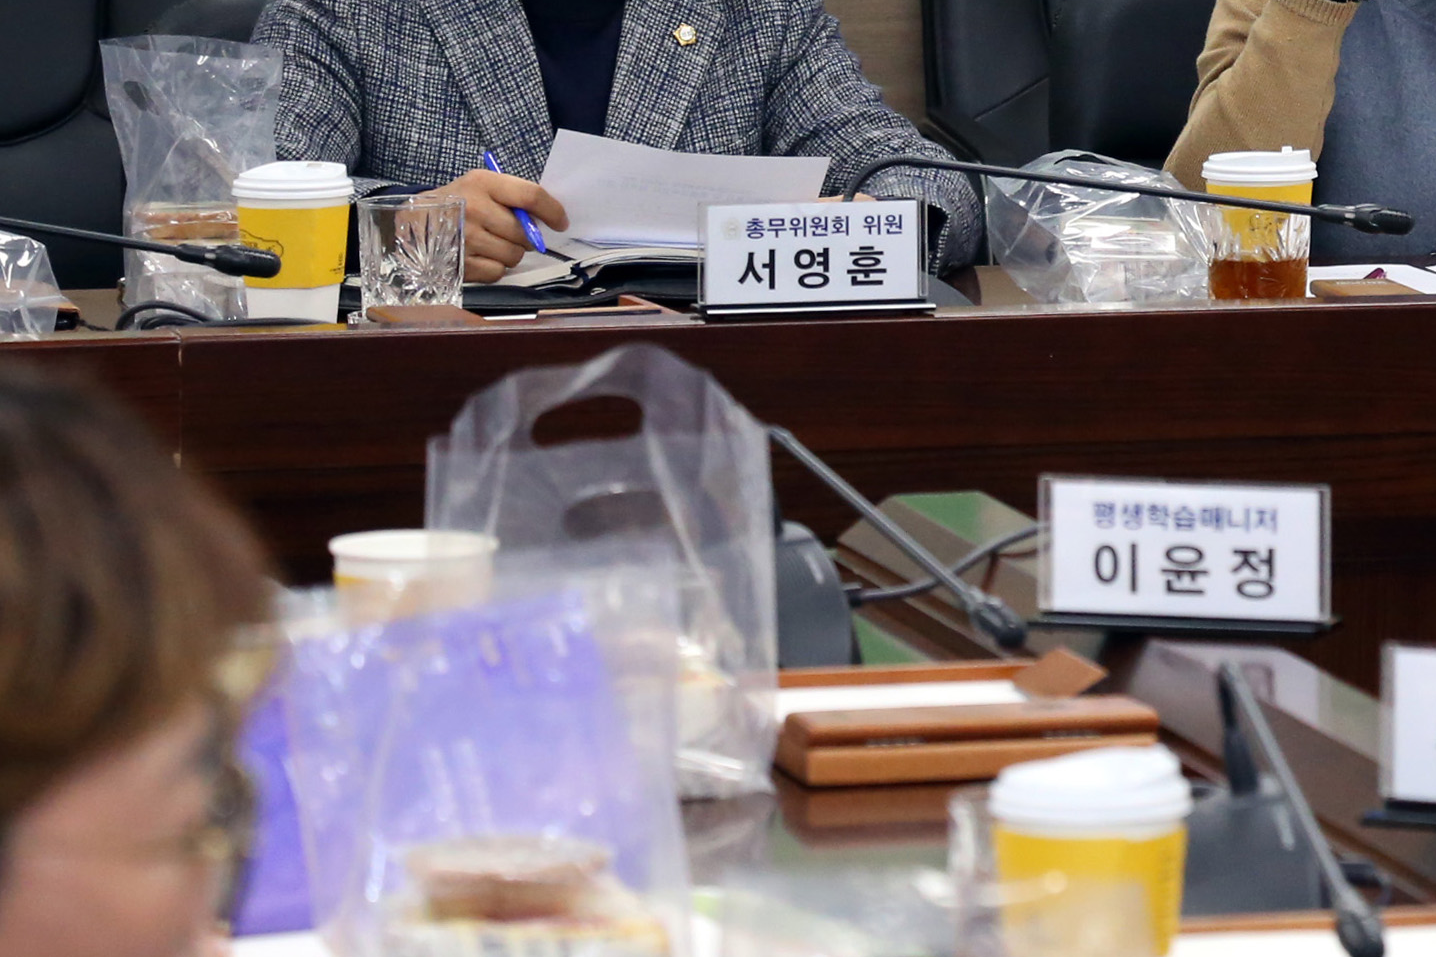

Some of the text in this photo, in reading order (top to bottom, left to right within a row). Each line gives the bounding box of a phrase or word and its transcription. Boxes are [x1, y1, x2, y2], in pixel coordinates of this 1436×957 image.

[745, 213, 903, 240] 총무위원회 위원
[1092, 501, 1278, 534] 평생학습매니저
